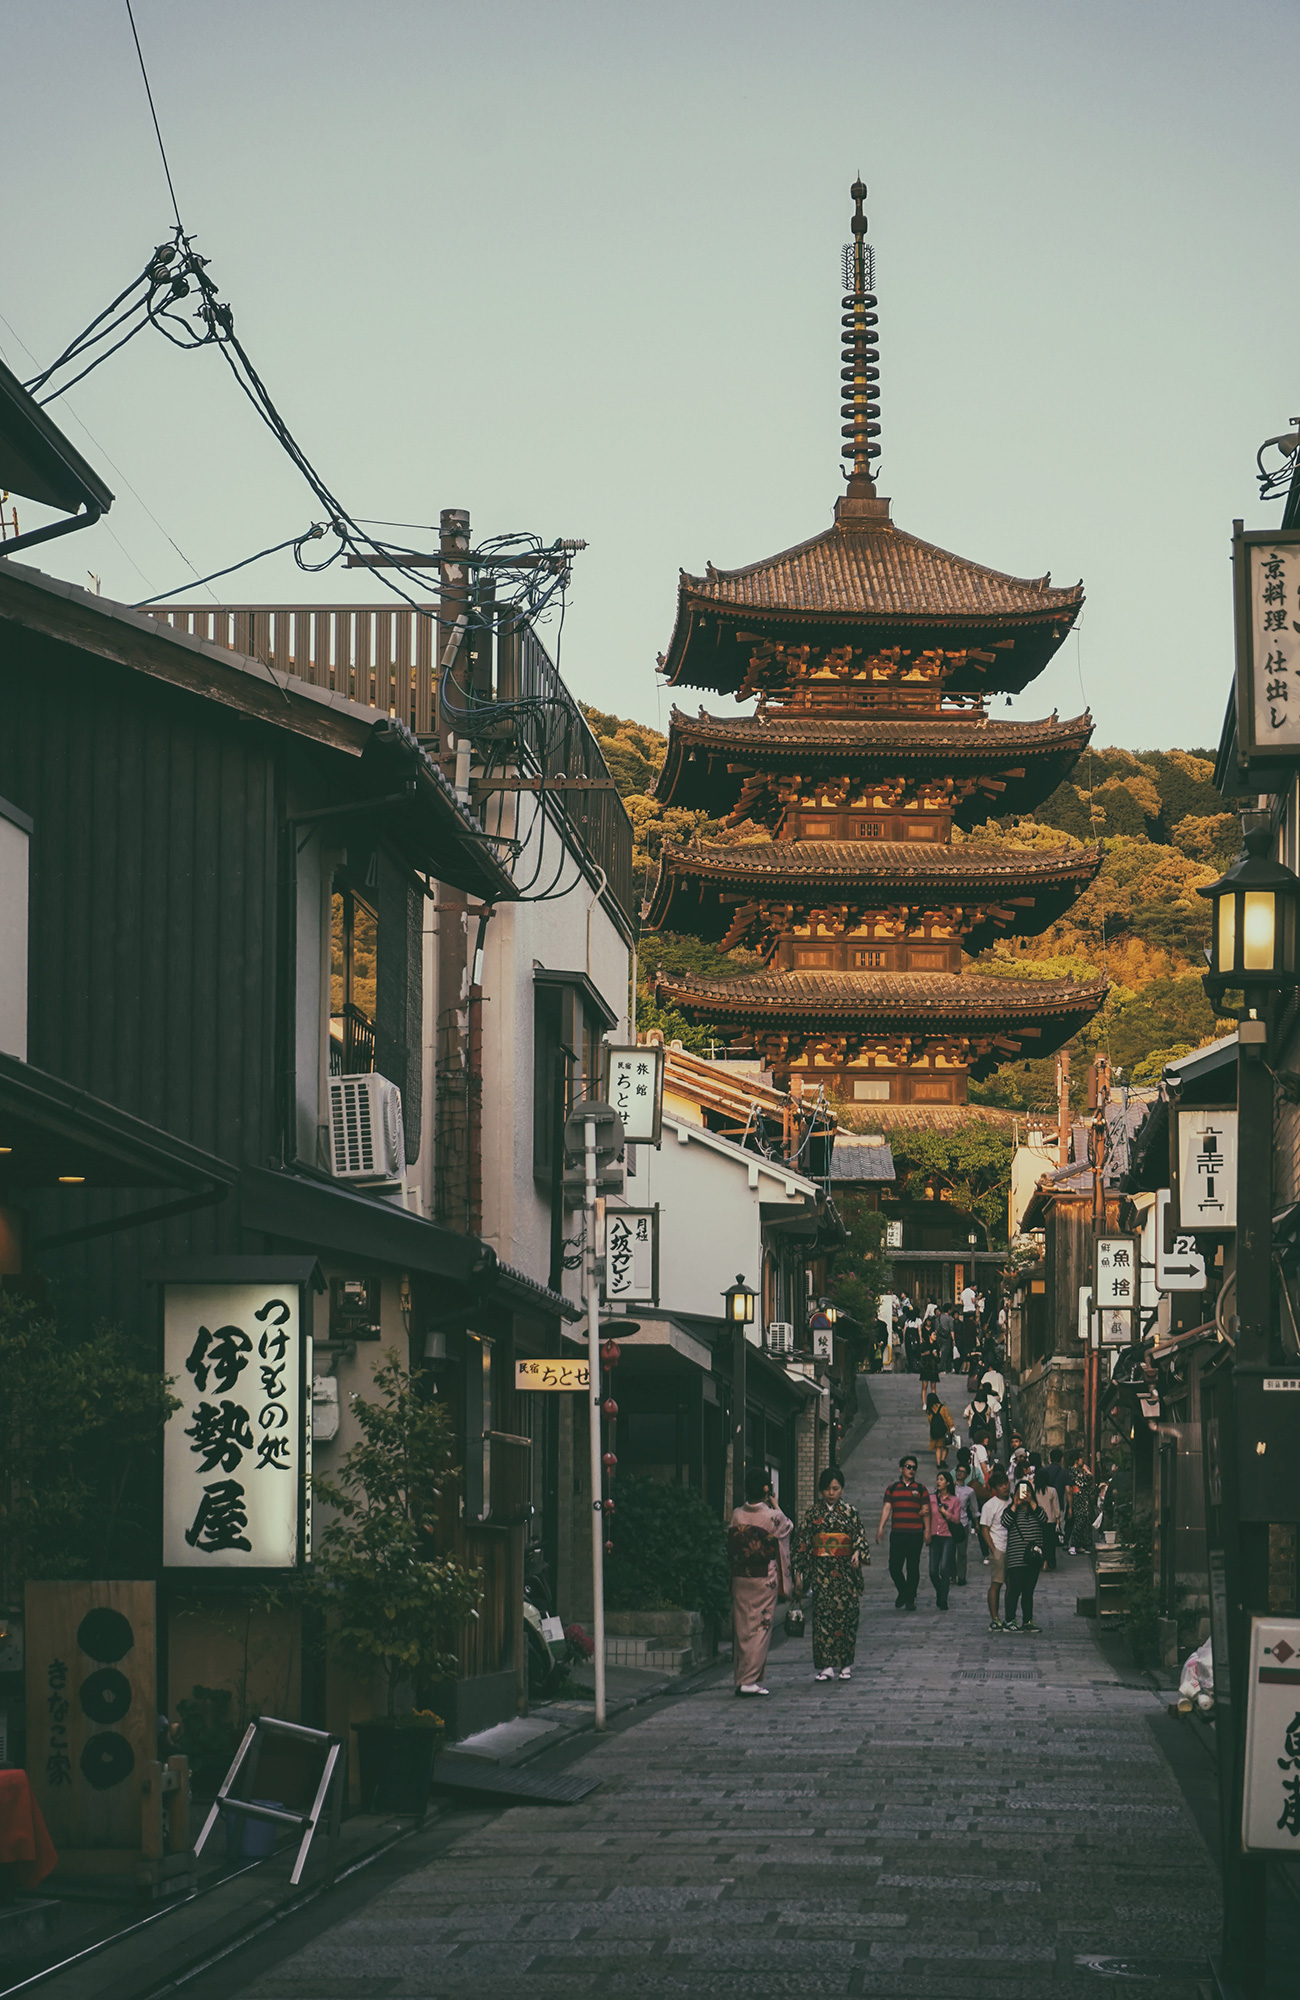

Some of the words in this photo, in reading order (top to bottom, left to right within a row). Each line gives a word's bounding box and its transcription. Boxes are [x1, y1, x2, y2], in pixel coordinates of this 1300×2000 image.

[1261, 553, 1289, 729] 京料理・仕出し
[636, 1062, 649, 1096] 旅館
[610, 1216, 633, 1294] 八坂ガレージ
[635, 1218, 649, 1242] 月極
[254, 1298, 291, 1470] つけもの処
[519, 1362, 540, 1374] 民宿
[542, 1366, 590, 1386] ちとせ
[184, 1325, 254, 1552] 伊勢屋
[46, 1657, 73, 1787] きなこ家
